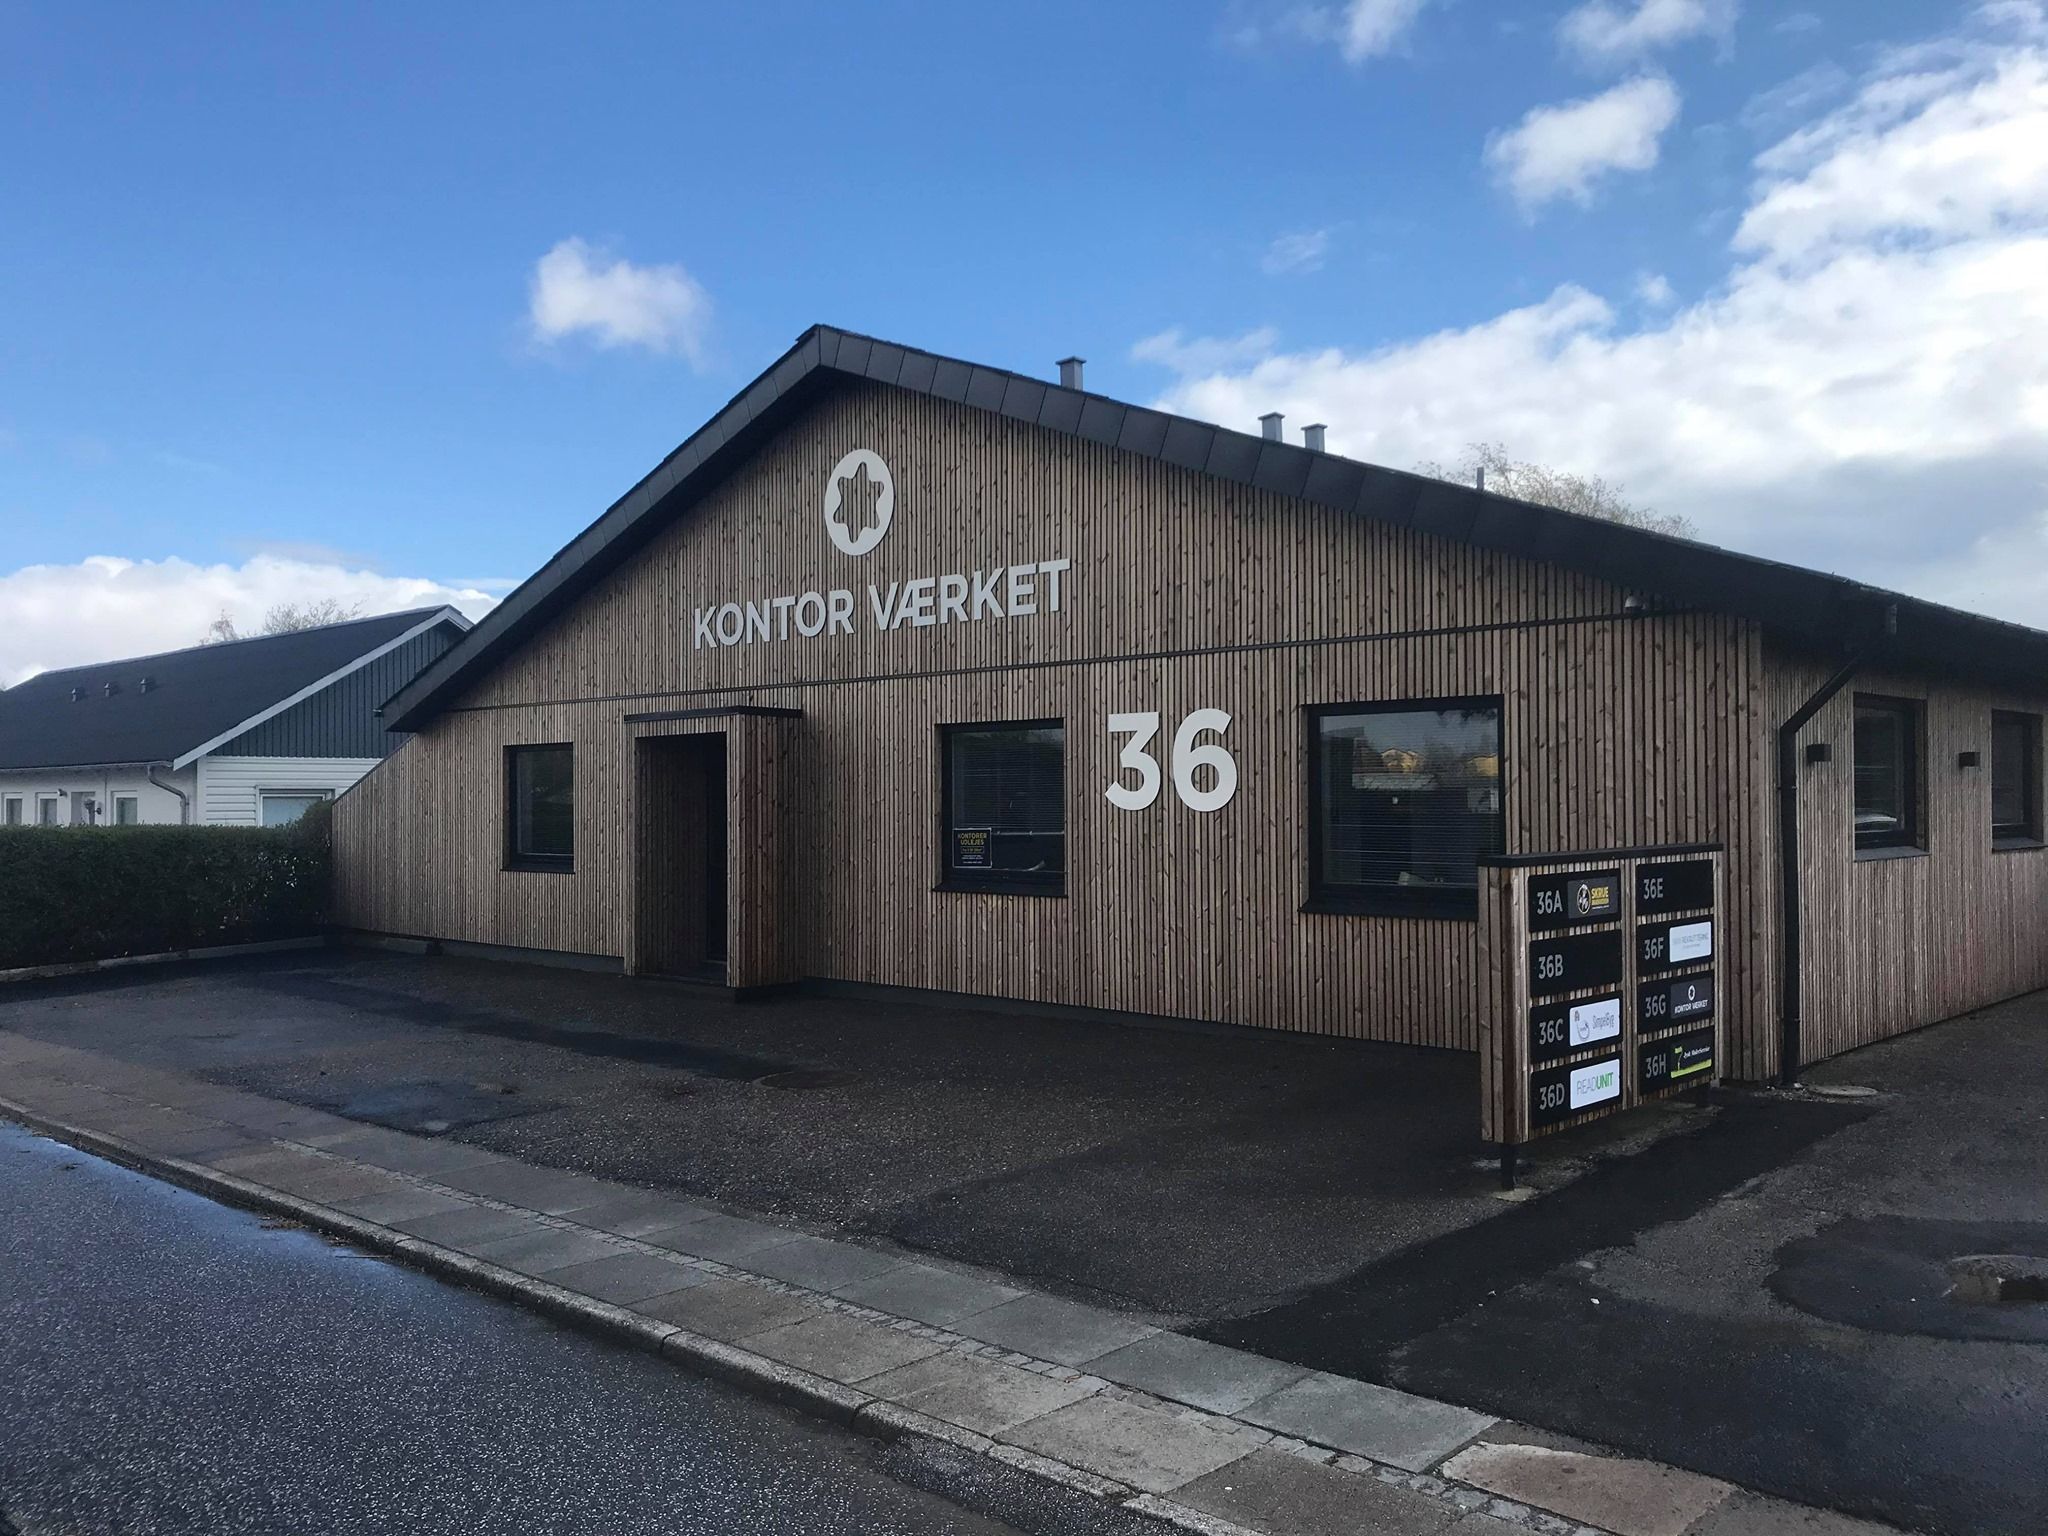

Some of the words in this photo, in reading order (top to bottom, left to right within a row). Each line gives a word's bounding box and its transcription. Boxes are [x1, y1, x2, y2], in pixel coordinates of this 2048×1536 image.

[693, 589, 855, 650] KONTOR
[868, 558, 1072, 631] VÆRKET
[1104, 708, 1238, 812] 36
[1643, 878, 1664, 899] 36E
[1537, 889, 1563, 915] 36A
[1644, 937, 1665, 960] 36F
[1538, 954, 1564, 980] 36B
[1645, 994, 1667, 1018] 36G
[1674, 1002, 1692, 1014] KONTOR
[1538, 1018, 1564, 1044] 36C
[1645, 1054, 1667, 1078] 36H
[1539, 1083, 1565, 1110] 36D
